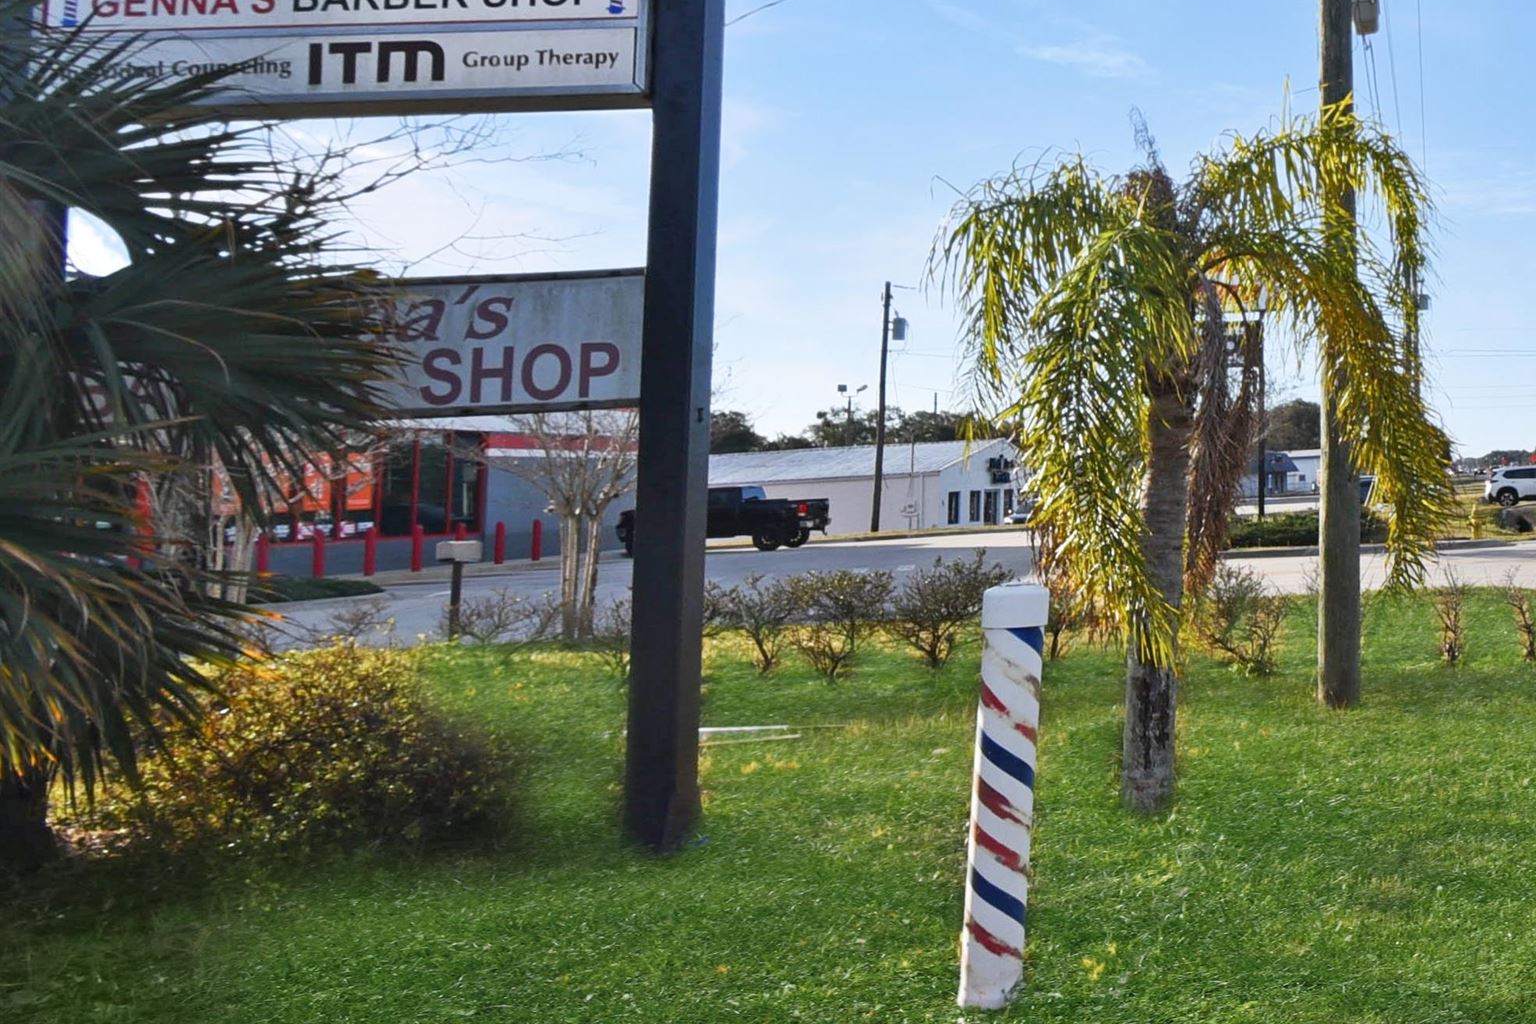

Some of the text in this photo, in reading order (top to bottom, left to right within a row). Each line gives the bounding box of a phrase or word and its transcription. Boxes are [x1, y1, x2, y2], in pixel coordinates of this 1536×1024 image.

[461, 47, 620, 72] Group Therapy
[418, 341, 621, 406] SHOP
